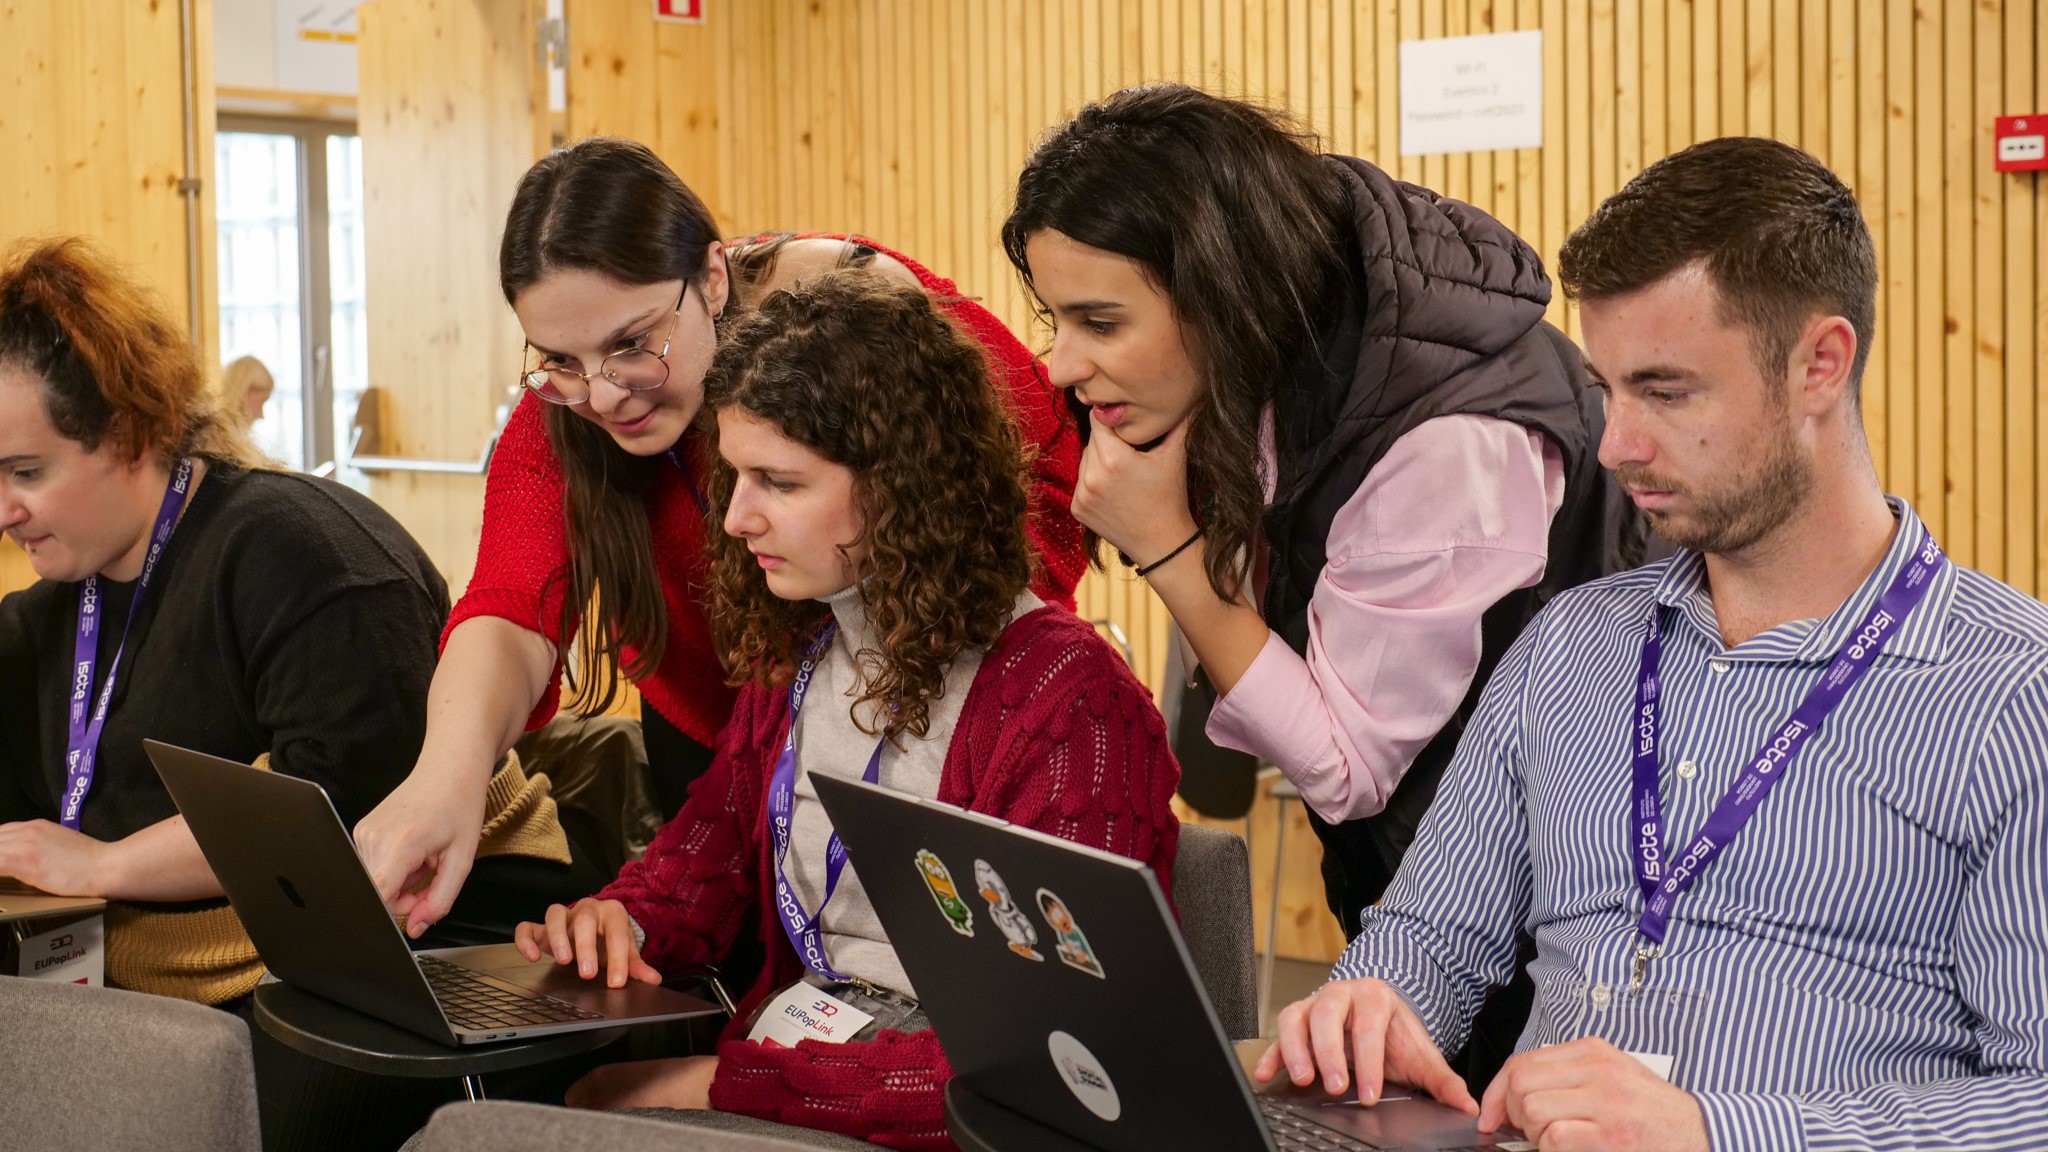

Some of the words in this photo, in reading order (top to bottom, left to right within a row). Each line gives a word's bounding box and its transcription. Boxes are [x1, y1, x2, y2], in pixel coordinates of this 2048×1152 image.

[84, 576, 98, 614] scte
[1847, 609, 1896, 660] iscte
[74, 660, 92, 700] iscte
[792, 660, 814, 711] iscte
[1638, 703, 1655, 758] iscte
[1755, 720, 1809, 774] iscte
[64, 776, 88, 821] iscte
[1640, 822, 1660, 882] iscte
[1664, 835, 1717, 893] iscte
[778, 882, 806, 935] iscte
[34, 947, 87, 971] EUPopLink
[784, 1004, 835, 1037] EUPopLink
